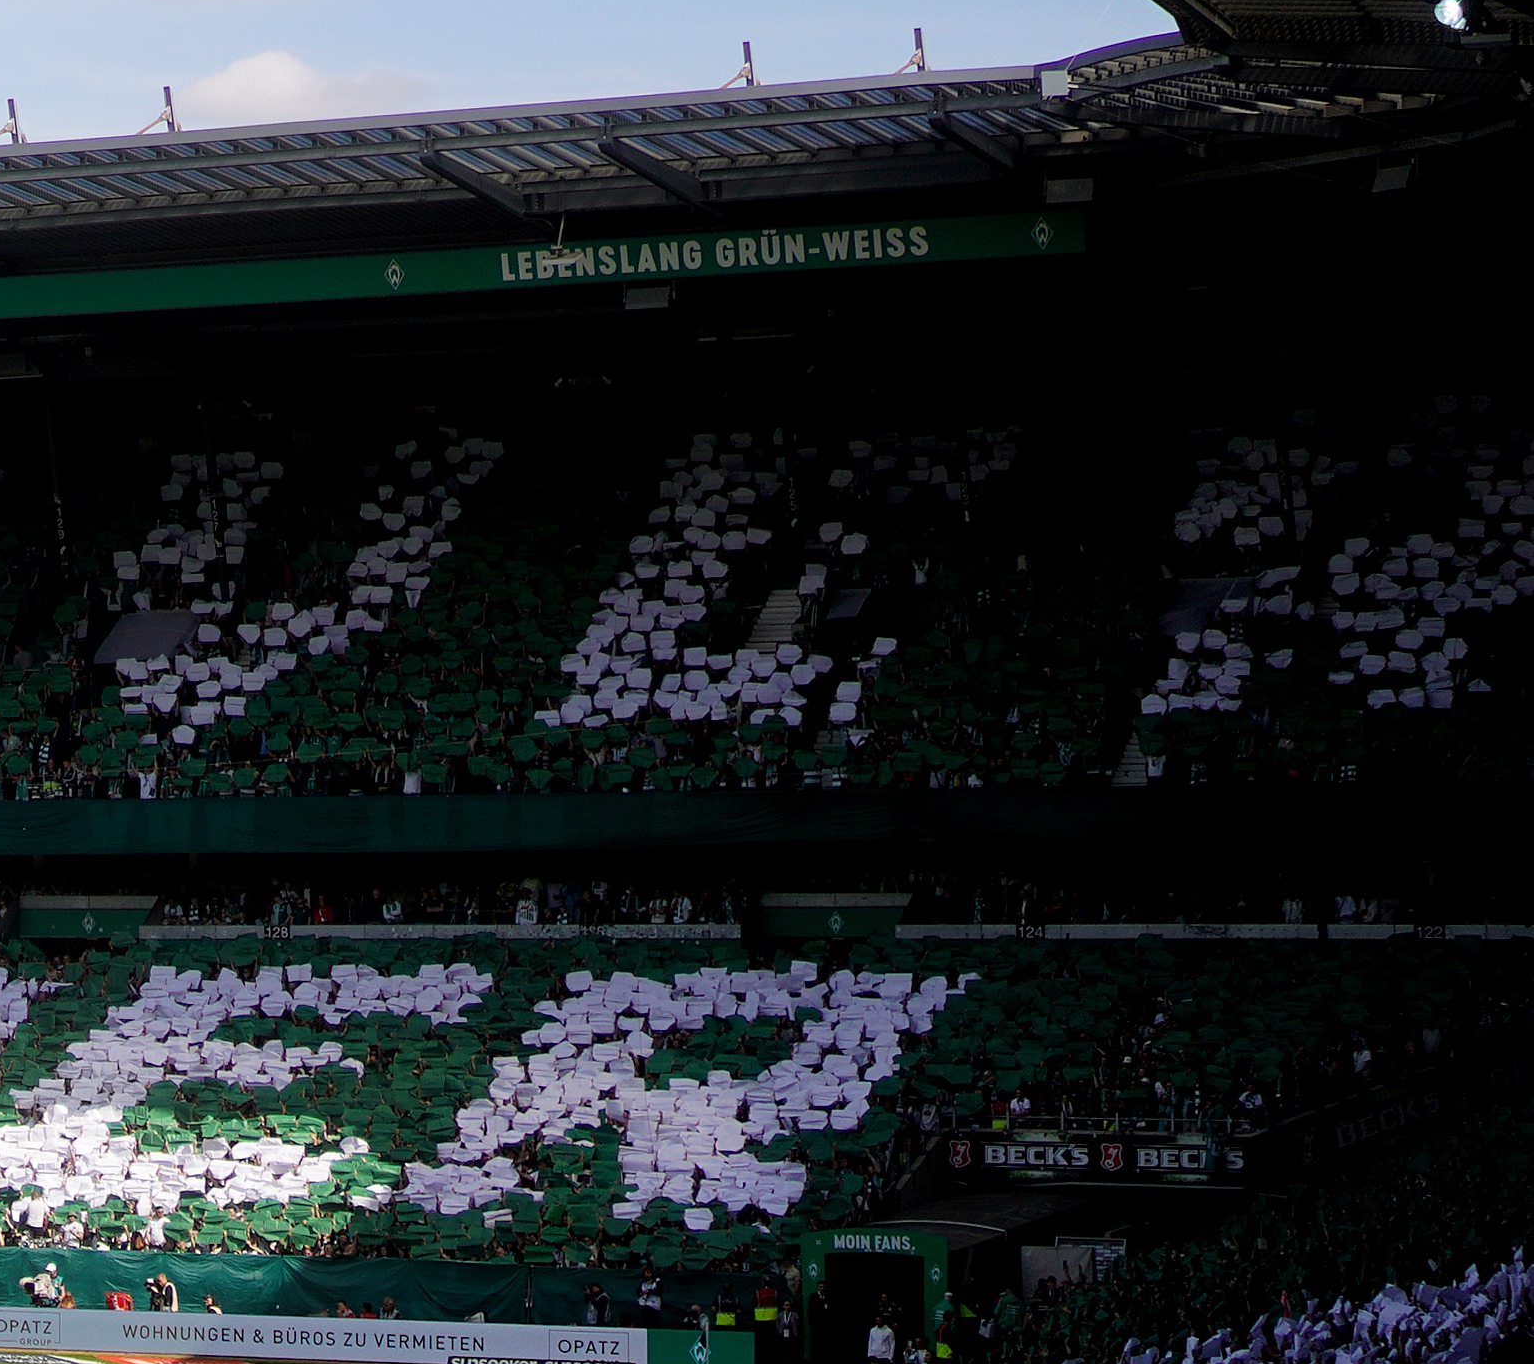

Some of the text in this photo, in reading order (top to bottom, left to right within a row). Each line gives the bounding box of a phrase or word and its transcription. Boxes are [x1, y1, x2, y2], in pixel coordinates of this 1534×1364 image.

[500, 224, 932, 285] LEBENSLANG GRÜN-WEISS
[56, 507, 66, 539] 129
[211, 497, 220, 533] 127
[265, 926, 289, 939] 128
[1017, 925, 1044, 939] 124
[1416, 925, 1443, 939] 122
[984, 1144, 1089, 1166] BECK'S
[834, 1234, 870, 1249] MOIN
[19, 1338, 53, 1346] GROUP
[122, 1324, 485, 1352] WOHNUNGEN & BÜROS ZU VERMIETEN
[558, 1339, 621, 1355] OPATZ
